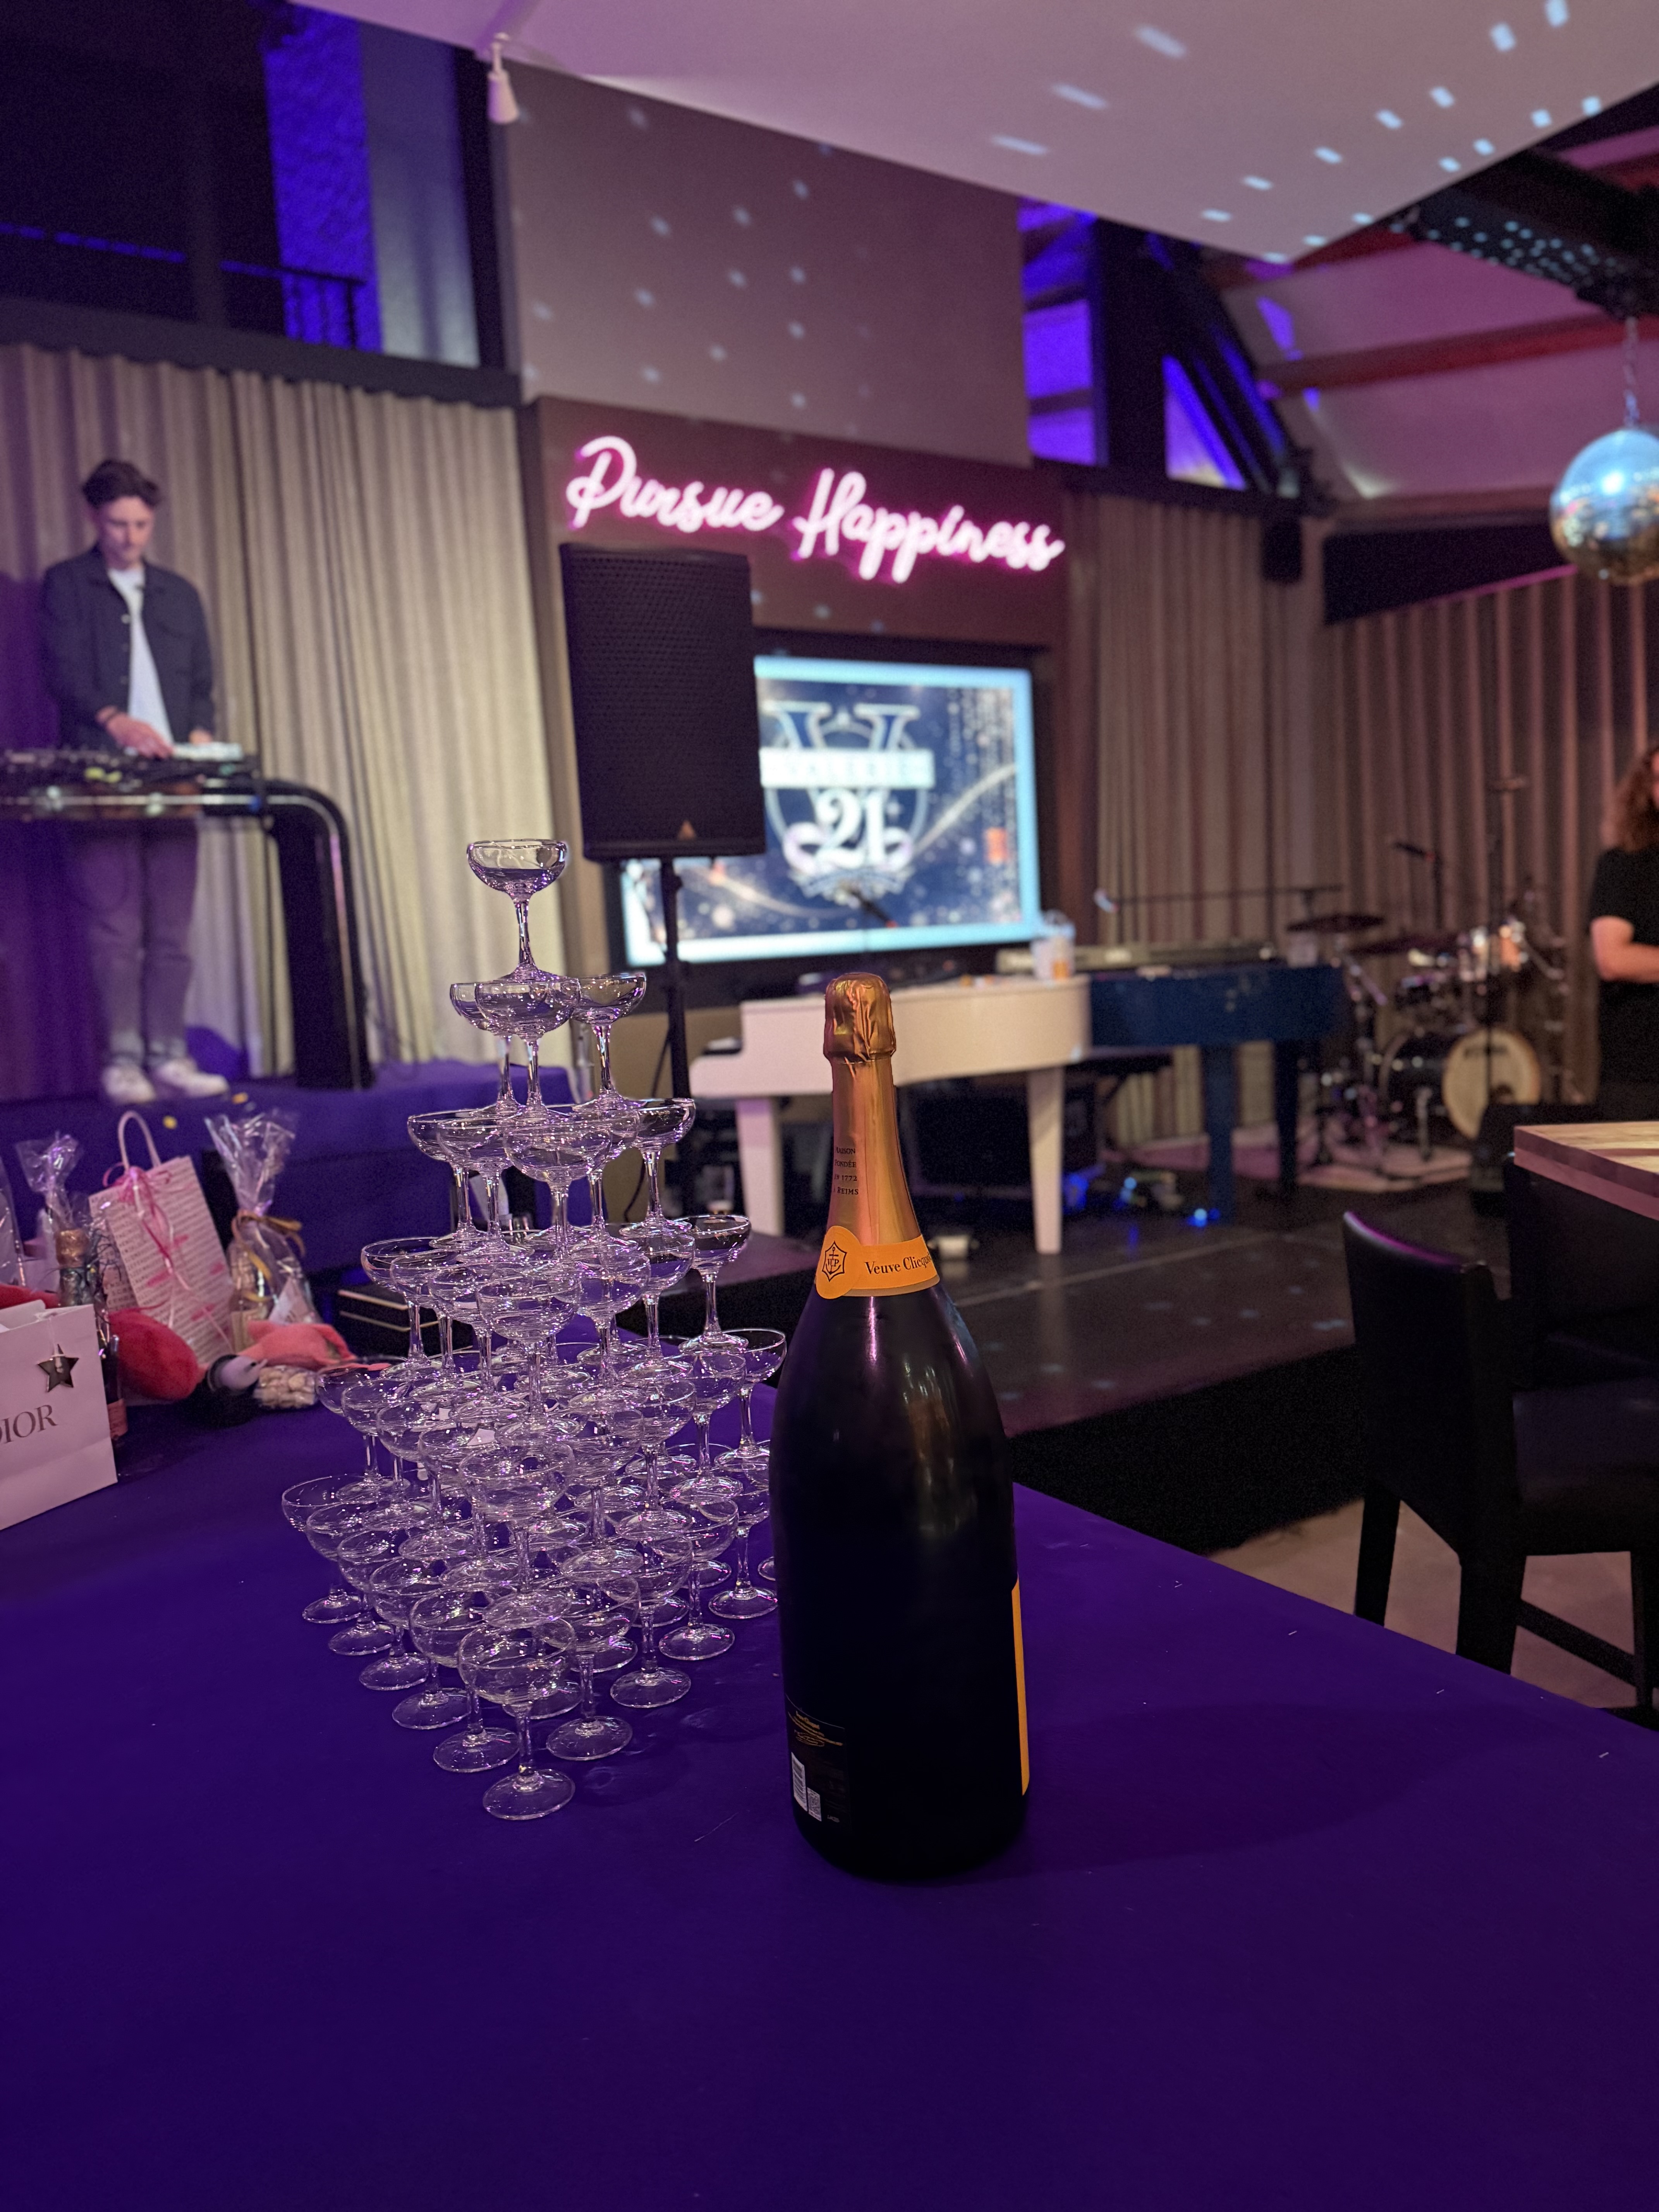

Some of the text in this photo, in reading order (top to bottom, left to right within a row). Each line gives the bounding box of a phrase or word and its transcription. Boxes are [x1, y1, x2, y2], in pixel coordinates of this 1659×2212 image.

[565, 434, 1066, 584] Pursue Happiness
[814, 788, 886, 870] 21
[837, 1187, 859, 1195] REIMS
[864, 1261, 901, 1274] Veuve
[0, 1405, 58, 1444] IOR
